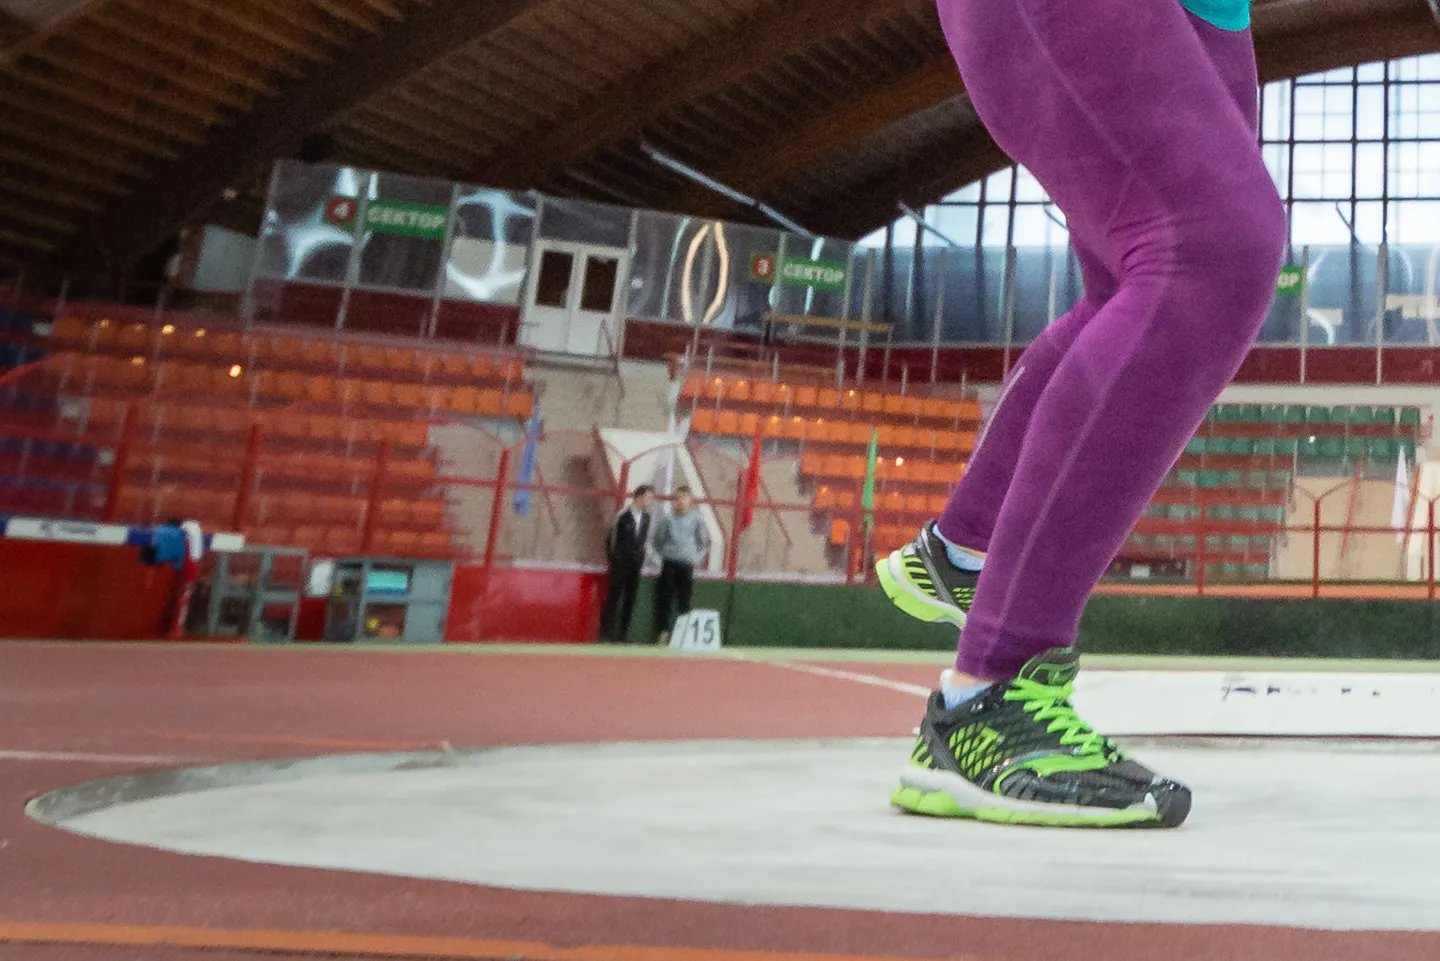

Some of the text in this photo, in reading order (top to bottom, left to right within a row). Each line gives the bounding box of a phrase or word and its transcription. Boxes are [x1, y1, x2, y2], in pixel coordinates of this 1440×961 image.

[367, 204, 446, 228] СЕКТОР
[783, 262, 845, 283] СЕКТОР
[692, 619, 715, 645] 15
